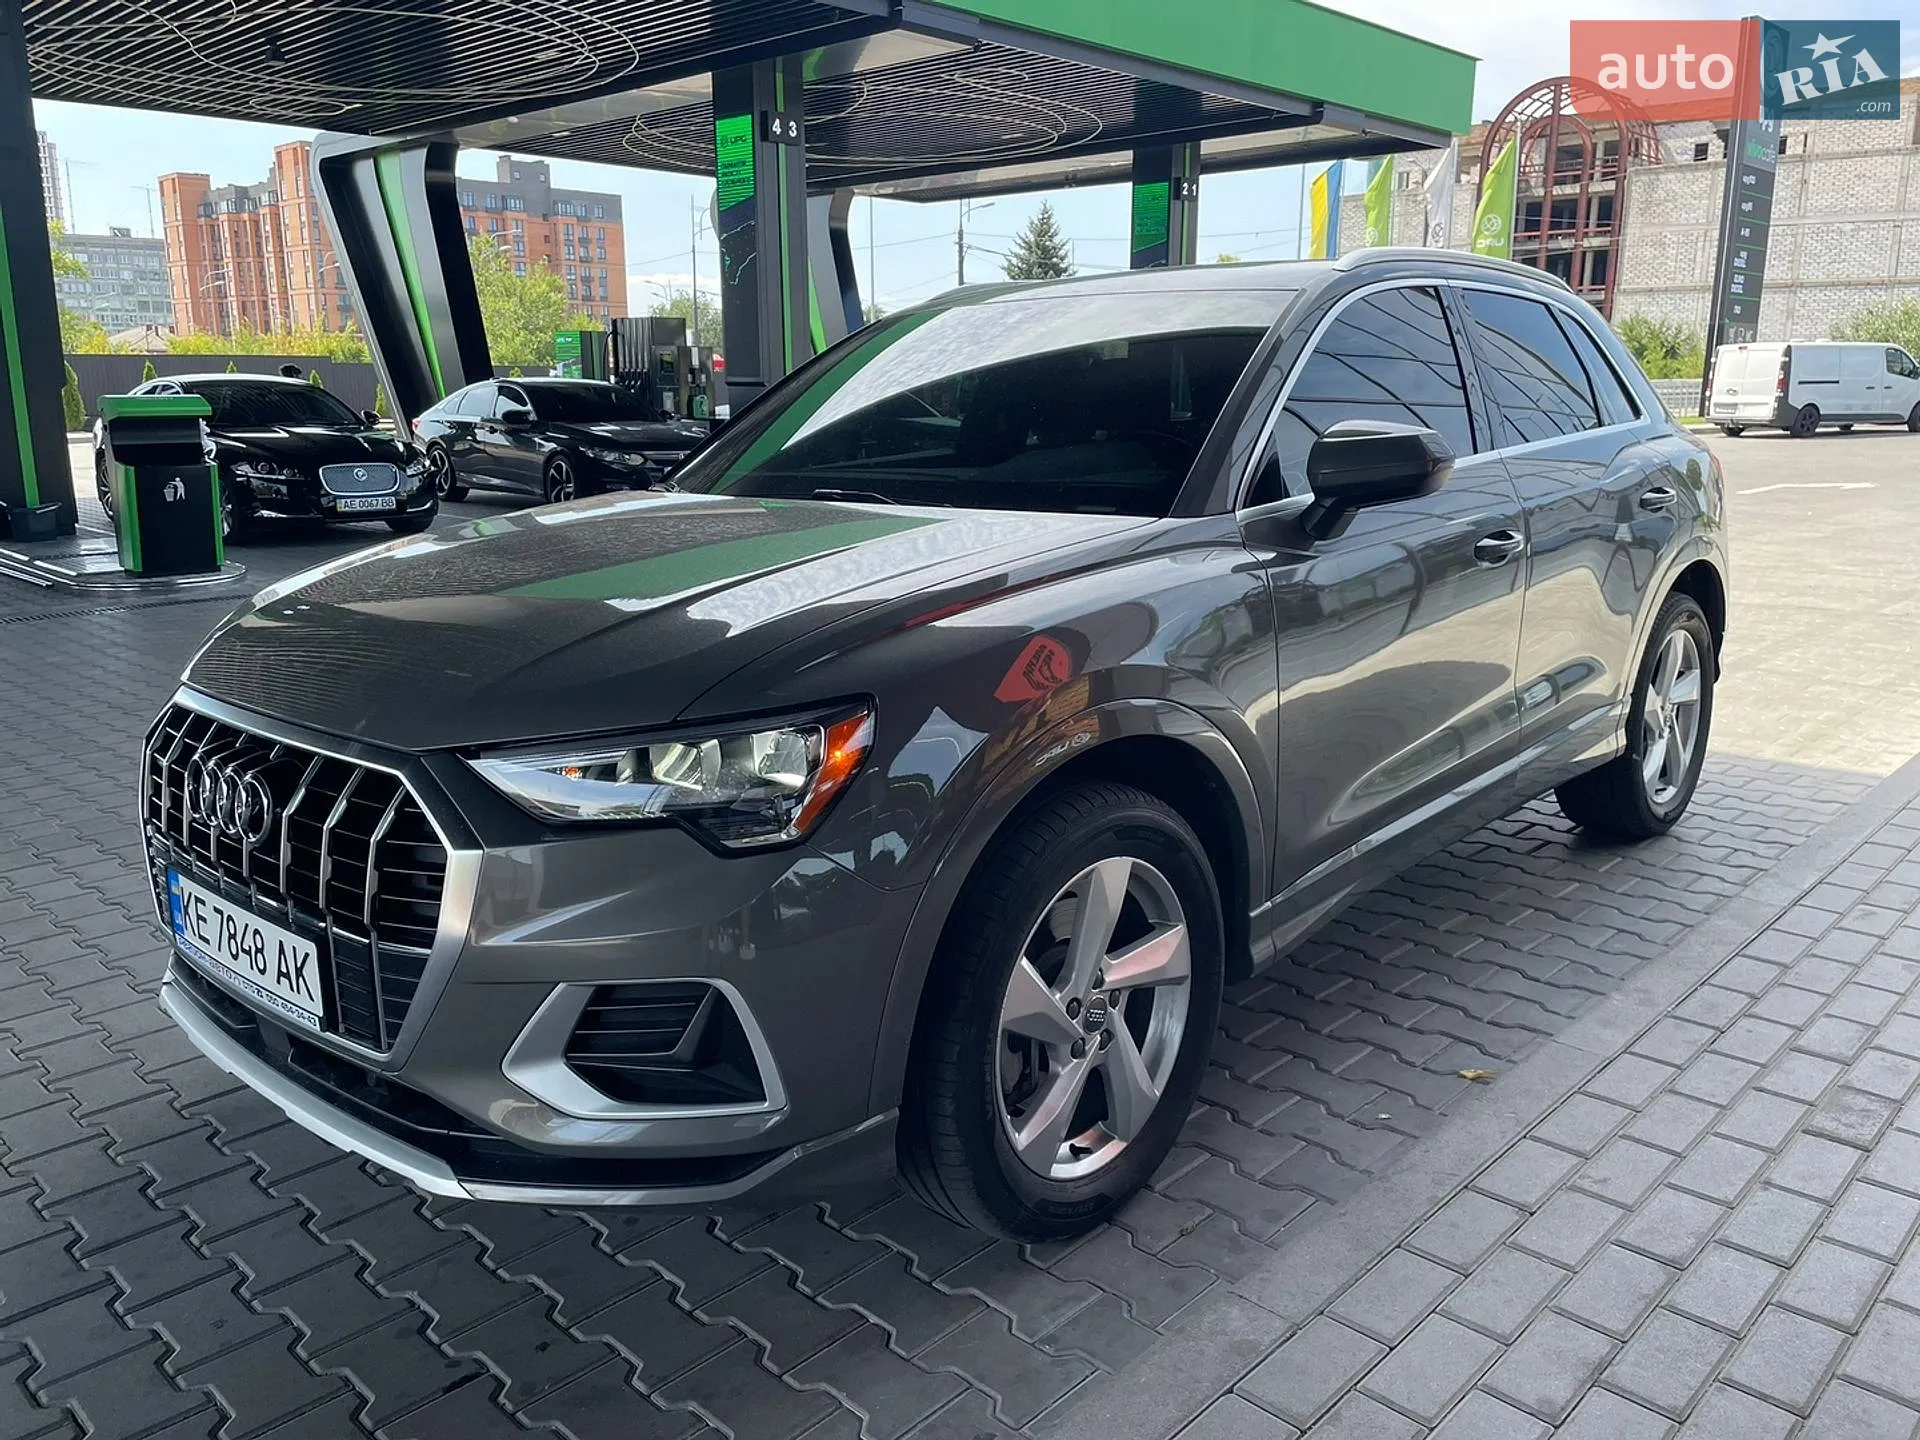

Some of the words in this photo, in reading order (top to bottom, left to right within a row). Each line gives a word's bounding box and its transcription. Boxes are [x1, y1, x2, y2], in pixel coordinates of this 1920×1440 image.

[772, 118, 782, 135] 4
[788, 121, 798, 138] 3
[1182, 182, 1189, 195] 2
[1191, 184, 1197, 196] 1
[344, 500, 357, 508] AE
[358, 499, 379, 508] 0067
[181, 886, 211, 946] KE
[213, 906, 267, 976] 7848
[276, 939, 315, 1003] AK
